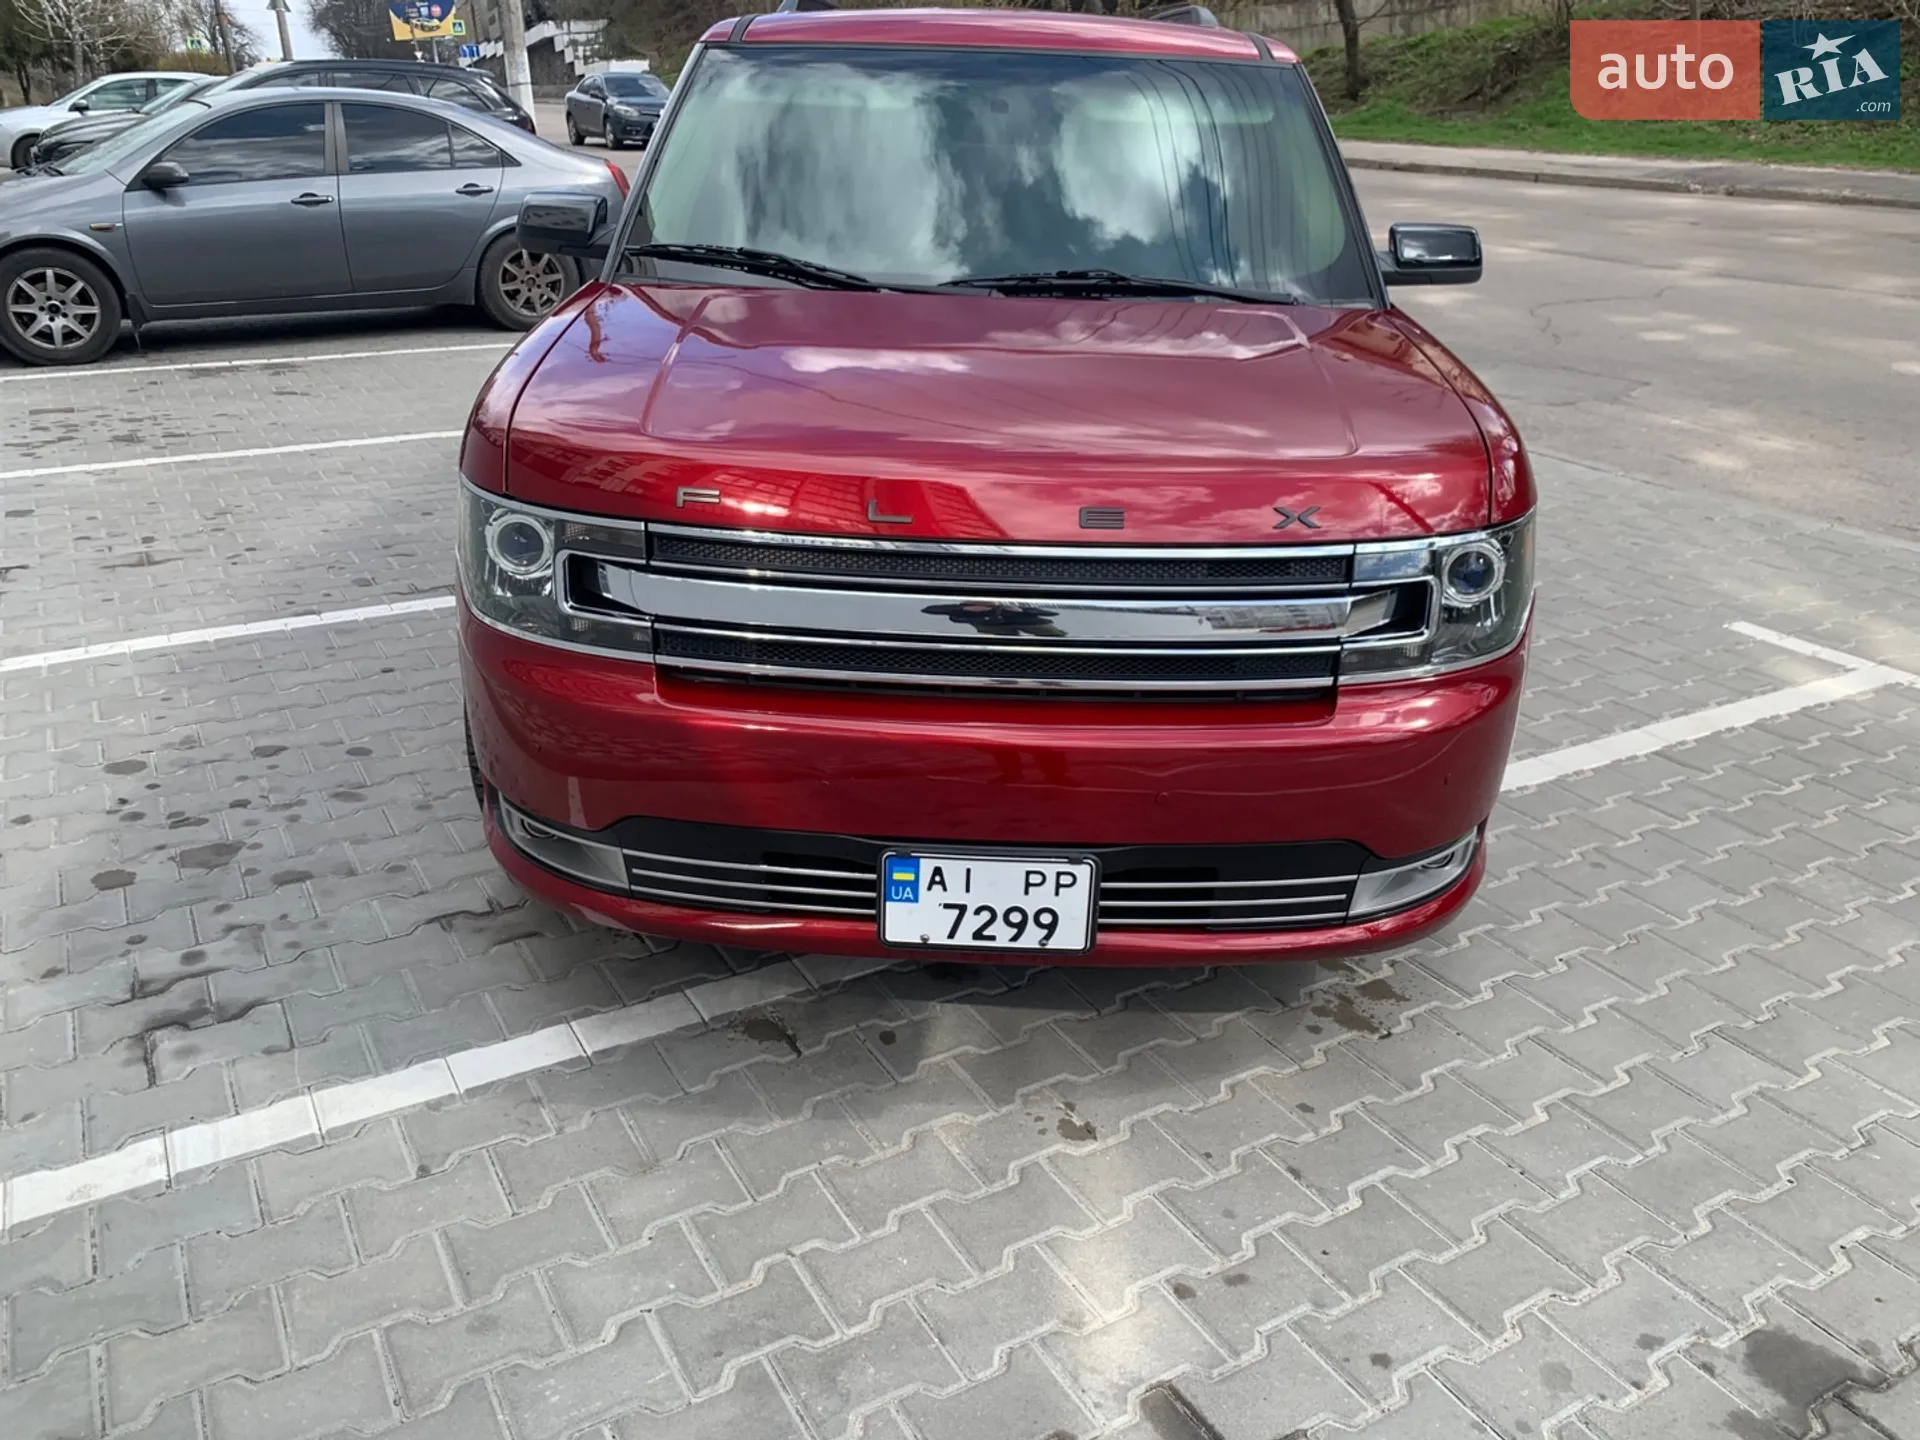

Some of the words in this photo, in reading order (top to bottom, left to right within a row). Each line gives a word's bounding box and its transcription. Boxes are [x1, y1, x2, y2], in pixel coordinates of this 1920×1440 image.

[676, 486, 1321, 529] FLEX
[891, 885, 915, 901] UA
[926, 865, 972, 894] AI
[1023, 869, 1078, 897] PP
[942, 902, 1060, 943] 7299
